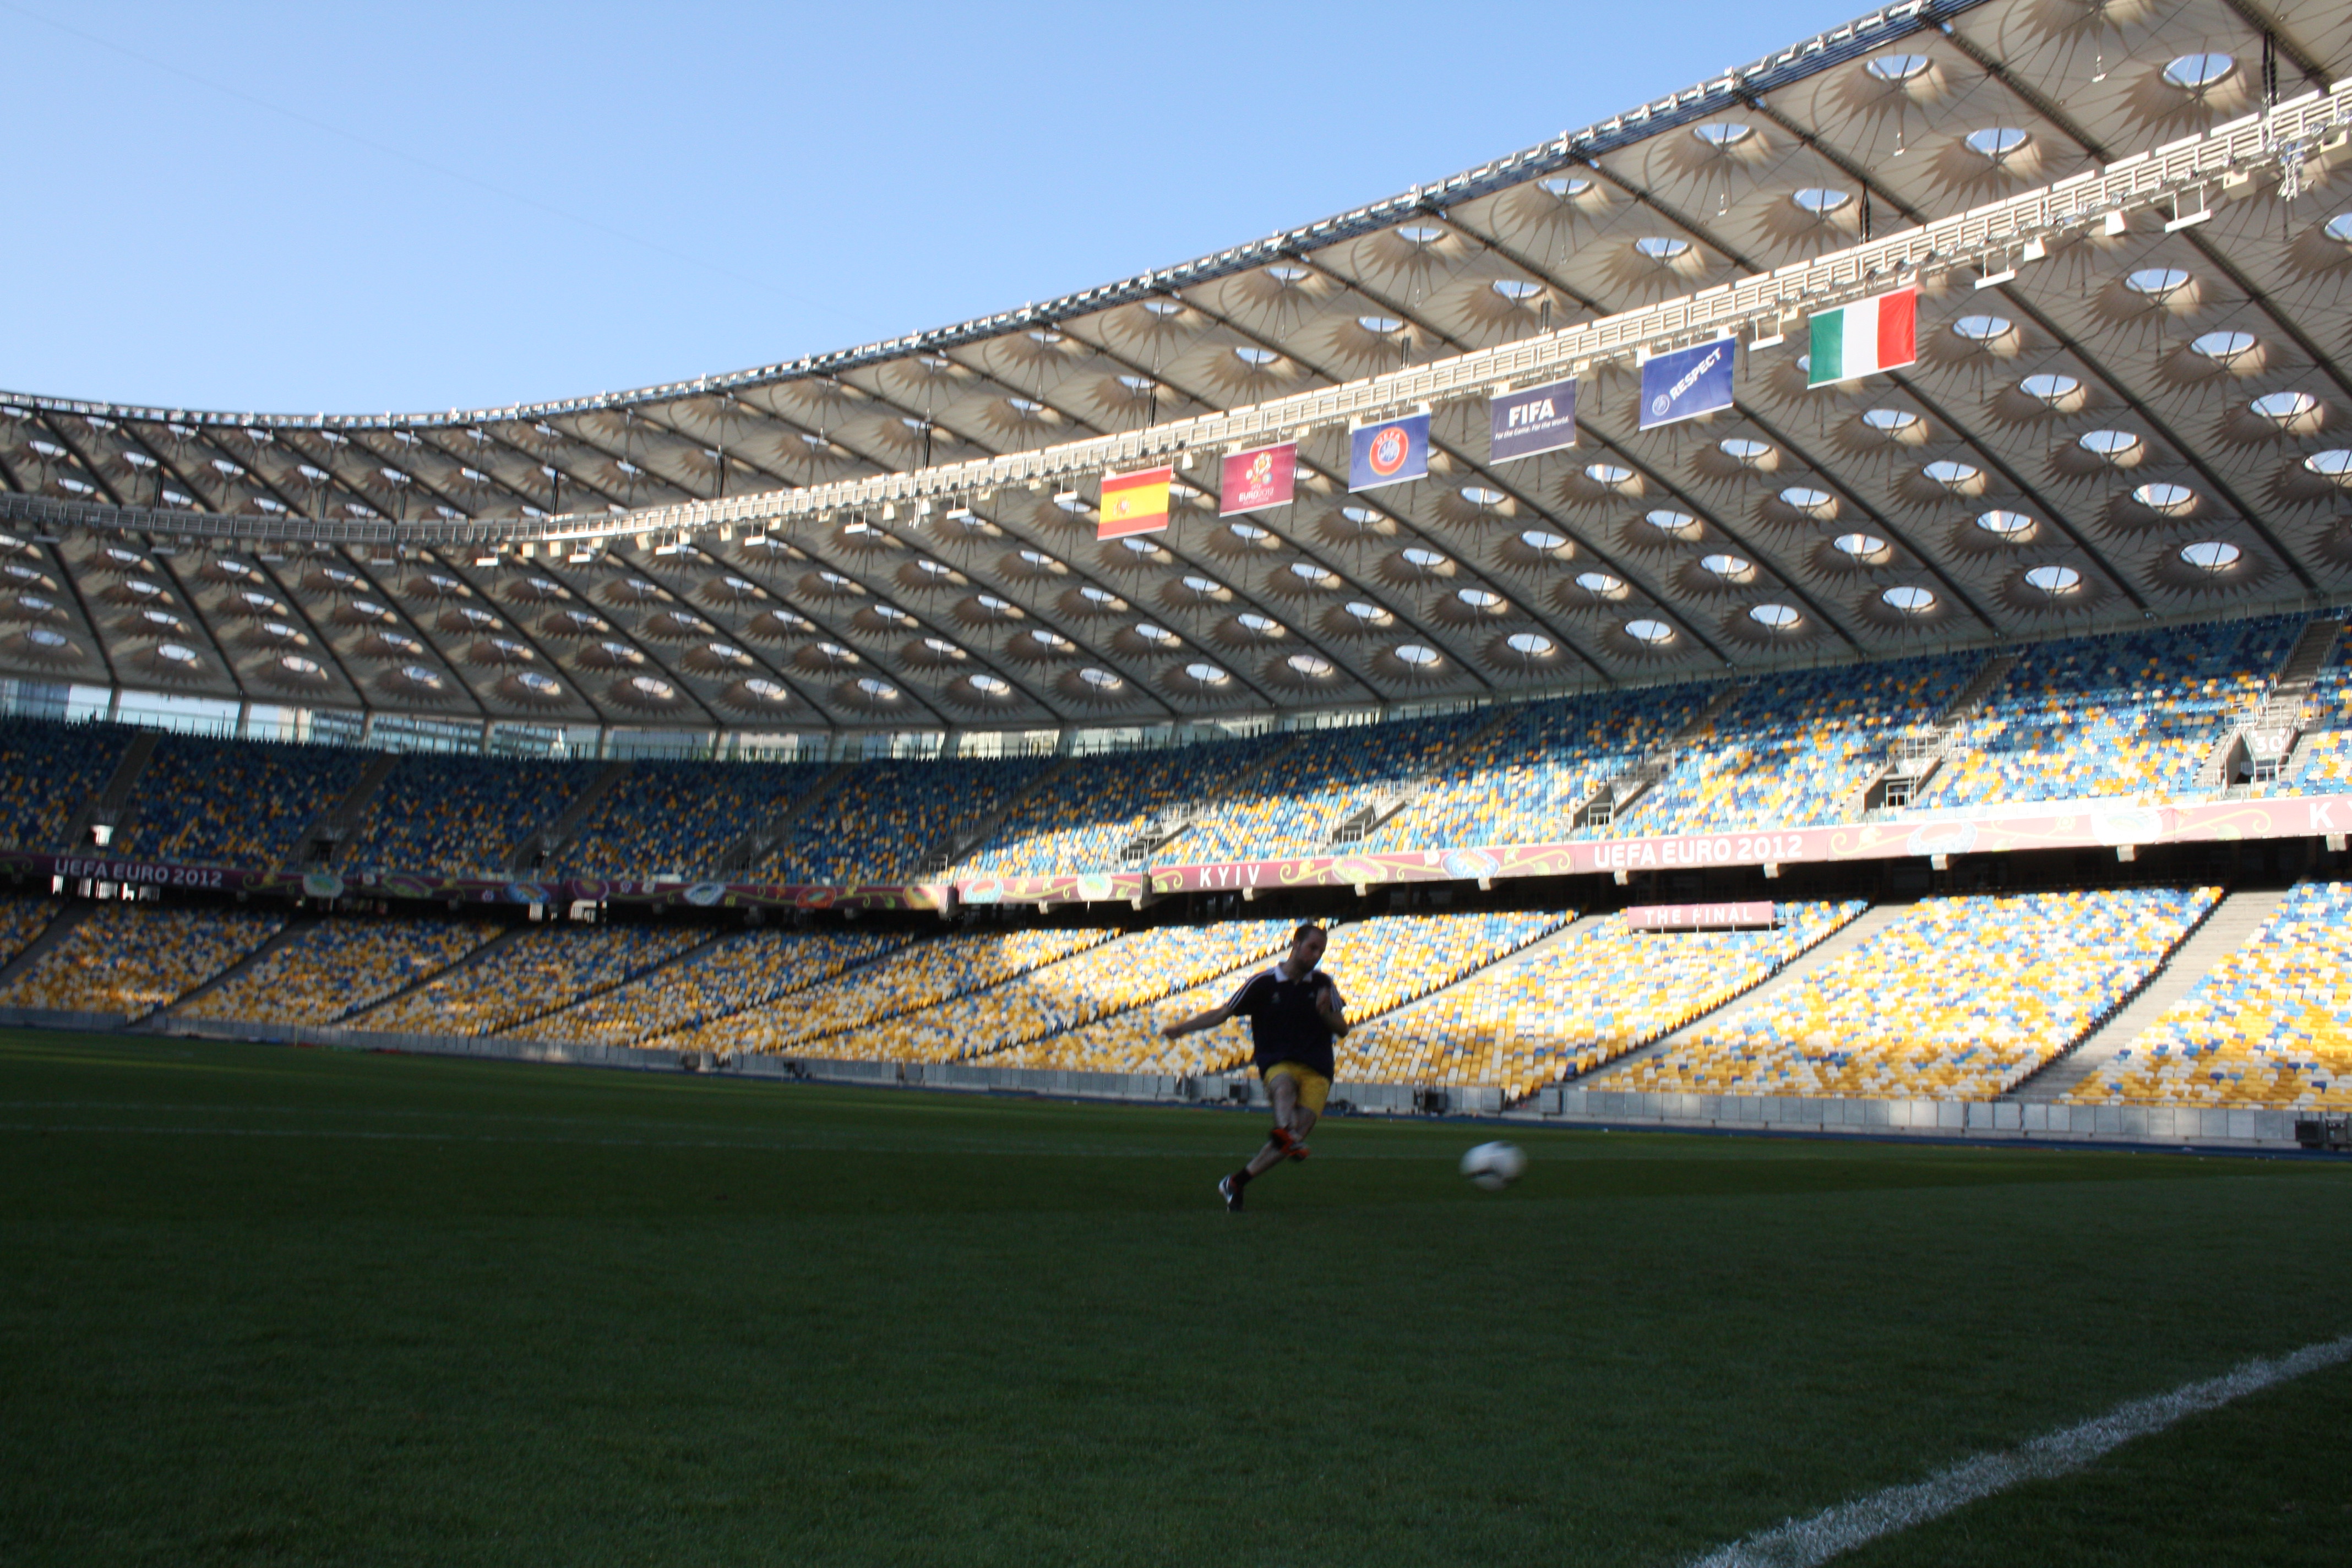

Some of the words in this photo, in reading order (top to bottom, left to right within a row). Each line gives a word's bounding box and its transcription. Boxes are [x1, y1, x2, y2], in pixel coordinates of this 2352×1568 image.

[1669, 347, 1721, 401] RESPECT
[1509, 398, 1556, 428] FIFA
[1377, 431, 1401, 446] UEFA
[2254, 735, 2284, 753] 30
[1594, 842, 1657, 869] UEFA
[1662, 837, 1732, 864] EURO
[1736, 834, 1803, 861] 2012
[55, 858, 108, 879] UEFA
[113, 863, 169, 884] EURO
[172, 868, 222, 888] 2012
[1199, 864, 1261, 888] KYIV
[1644, 908, 1682, 925] THE
[1692, 906, 1753, 924] FINAL
